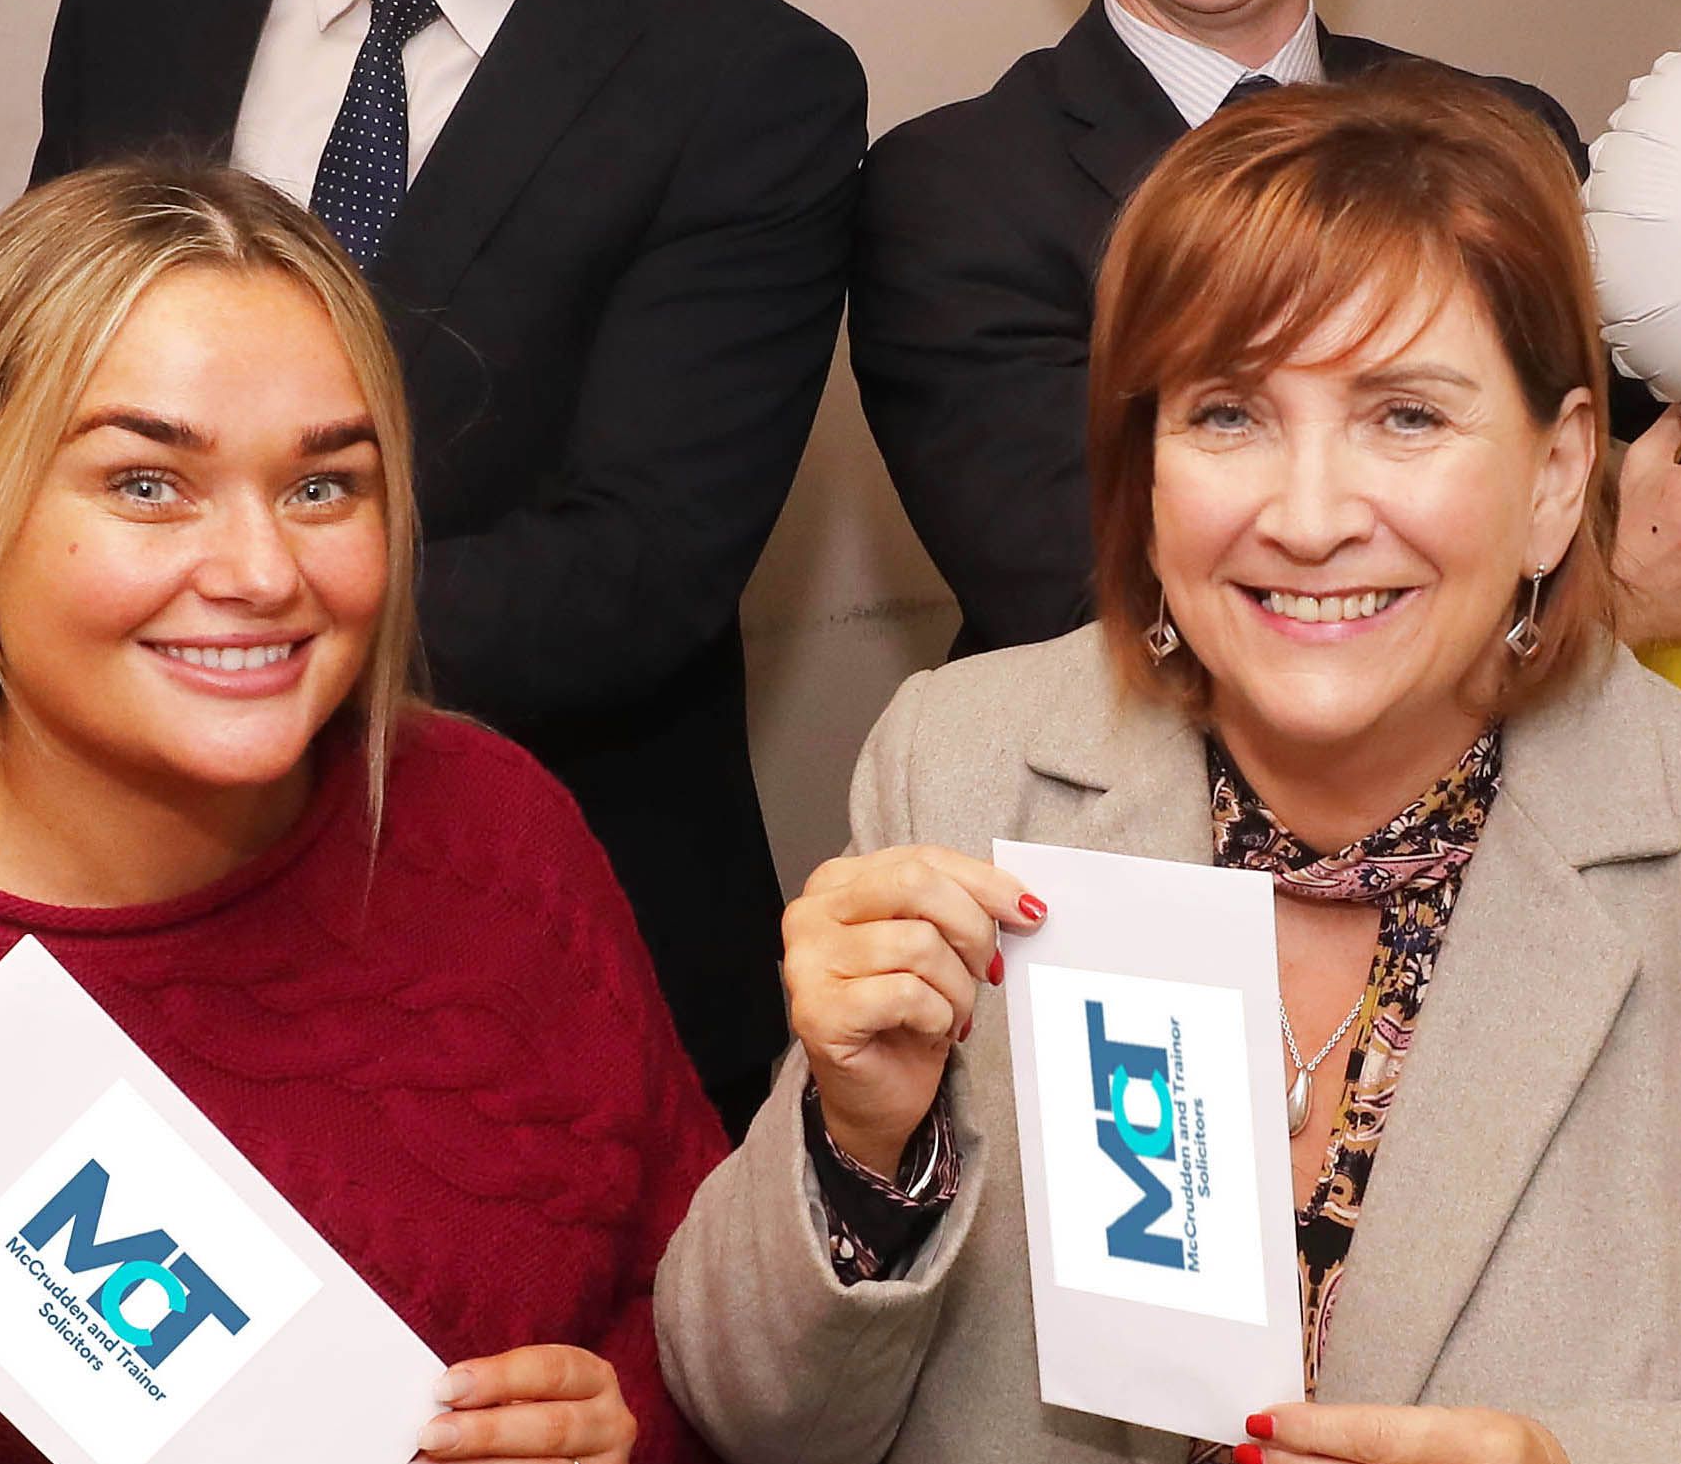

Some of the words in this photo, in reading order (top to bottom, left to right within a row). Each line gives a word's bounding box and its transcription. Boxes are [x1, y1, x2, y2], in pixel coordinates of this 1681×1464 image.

[1170, 1016, 1186, 1095] Trainor
[1173, 1100, 1189, 1141] and
[1194, 1097, 1211, 1198] Solicitors
[1179, 1146, 1200, 1273] McCrudden
[5, 1235, 89, 1326] McCrudden
[86, 1321, 121, 1354] and
[115, 1345, 167, 1403] Trainor
[38, 1301, 104, 1372] Solicitors
